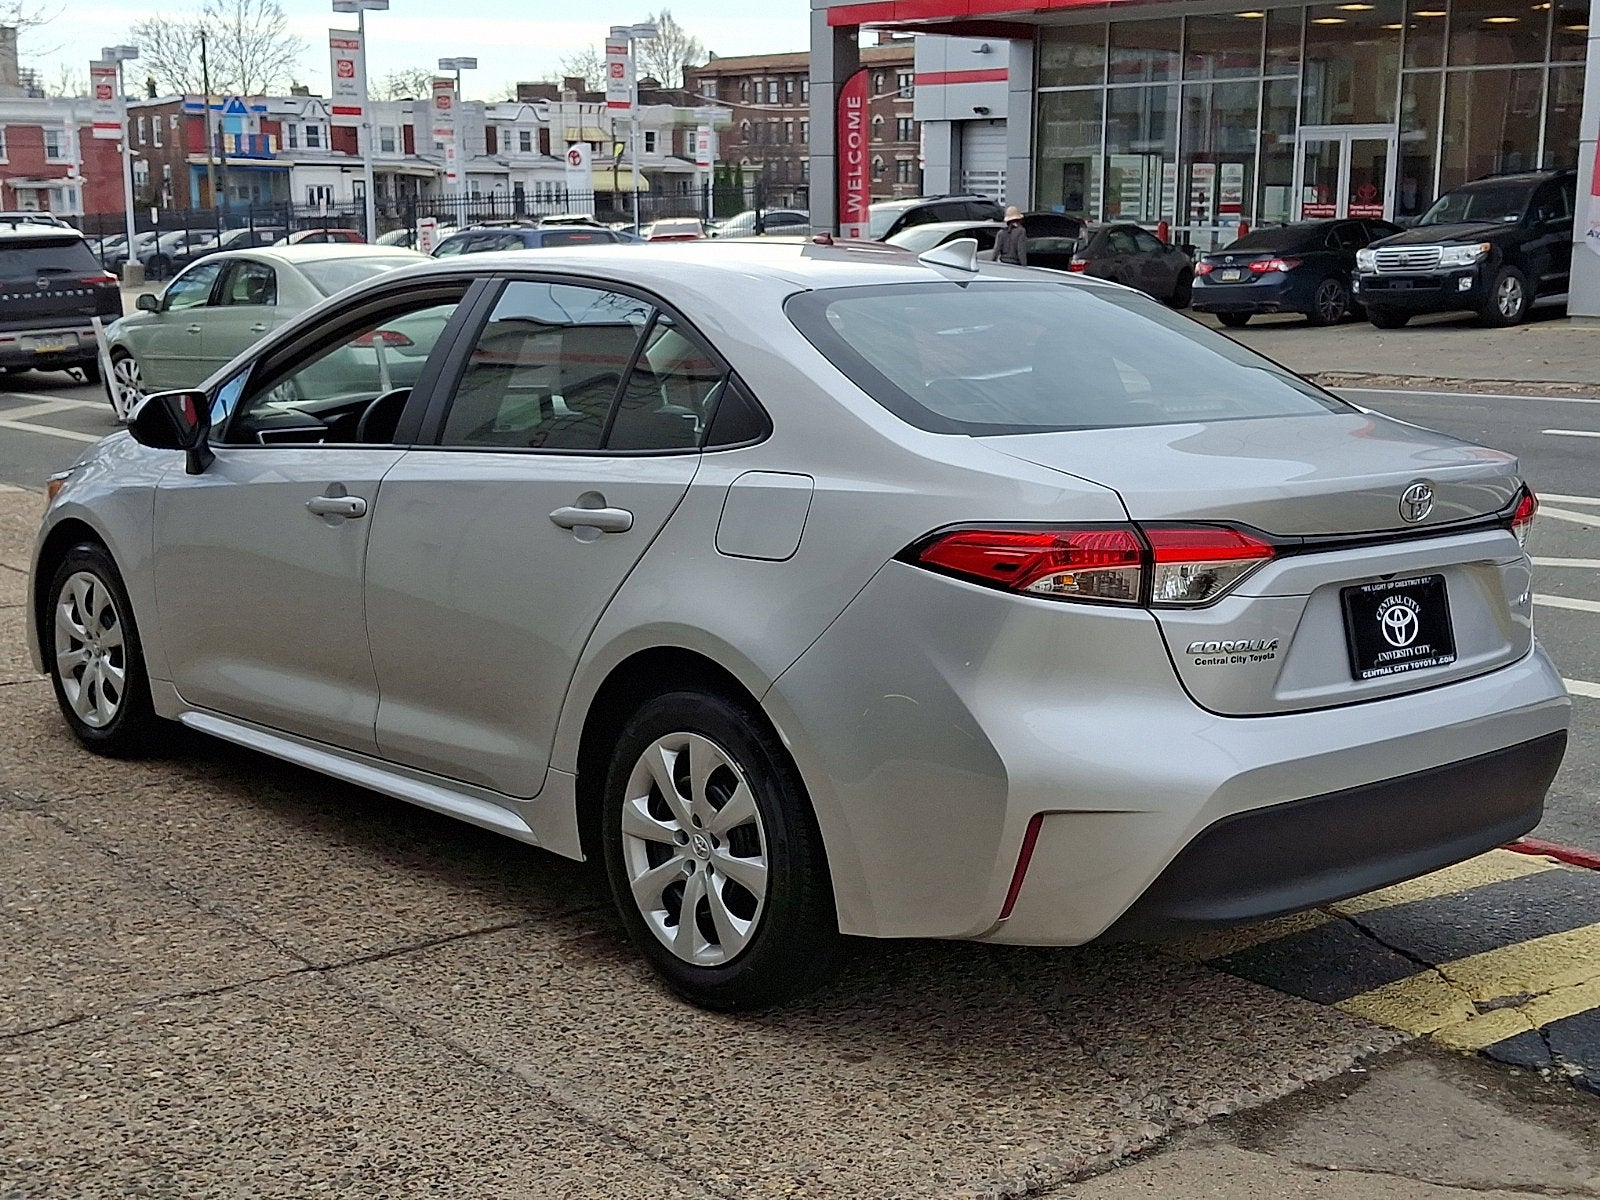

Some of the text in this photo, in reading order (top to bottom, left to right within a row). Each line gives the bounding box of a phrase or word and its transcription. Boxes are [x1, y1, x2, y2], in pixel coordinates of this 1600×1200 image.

[847, 96, 862, 213] WELCOME
[1371, 583, 1386, 591] LIGHT
[1394, 579, 1420, 588] CHESTNUT
[1376, 594, 1421, 621] CENTRAL CITY
[1186, 638, 1280, 654] COROLLA
[1378, 644, 1431, 662] UNIVERSITY CITY
[1194, 652, 1275, 666] Central City Toyota
[1362, 667, 1394, 679] CENTRAL
[1393, 664, 1409, 673] CITY
[1410, 660, 1437, 669] TOYOTA
